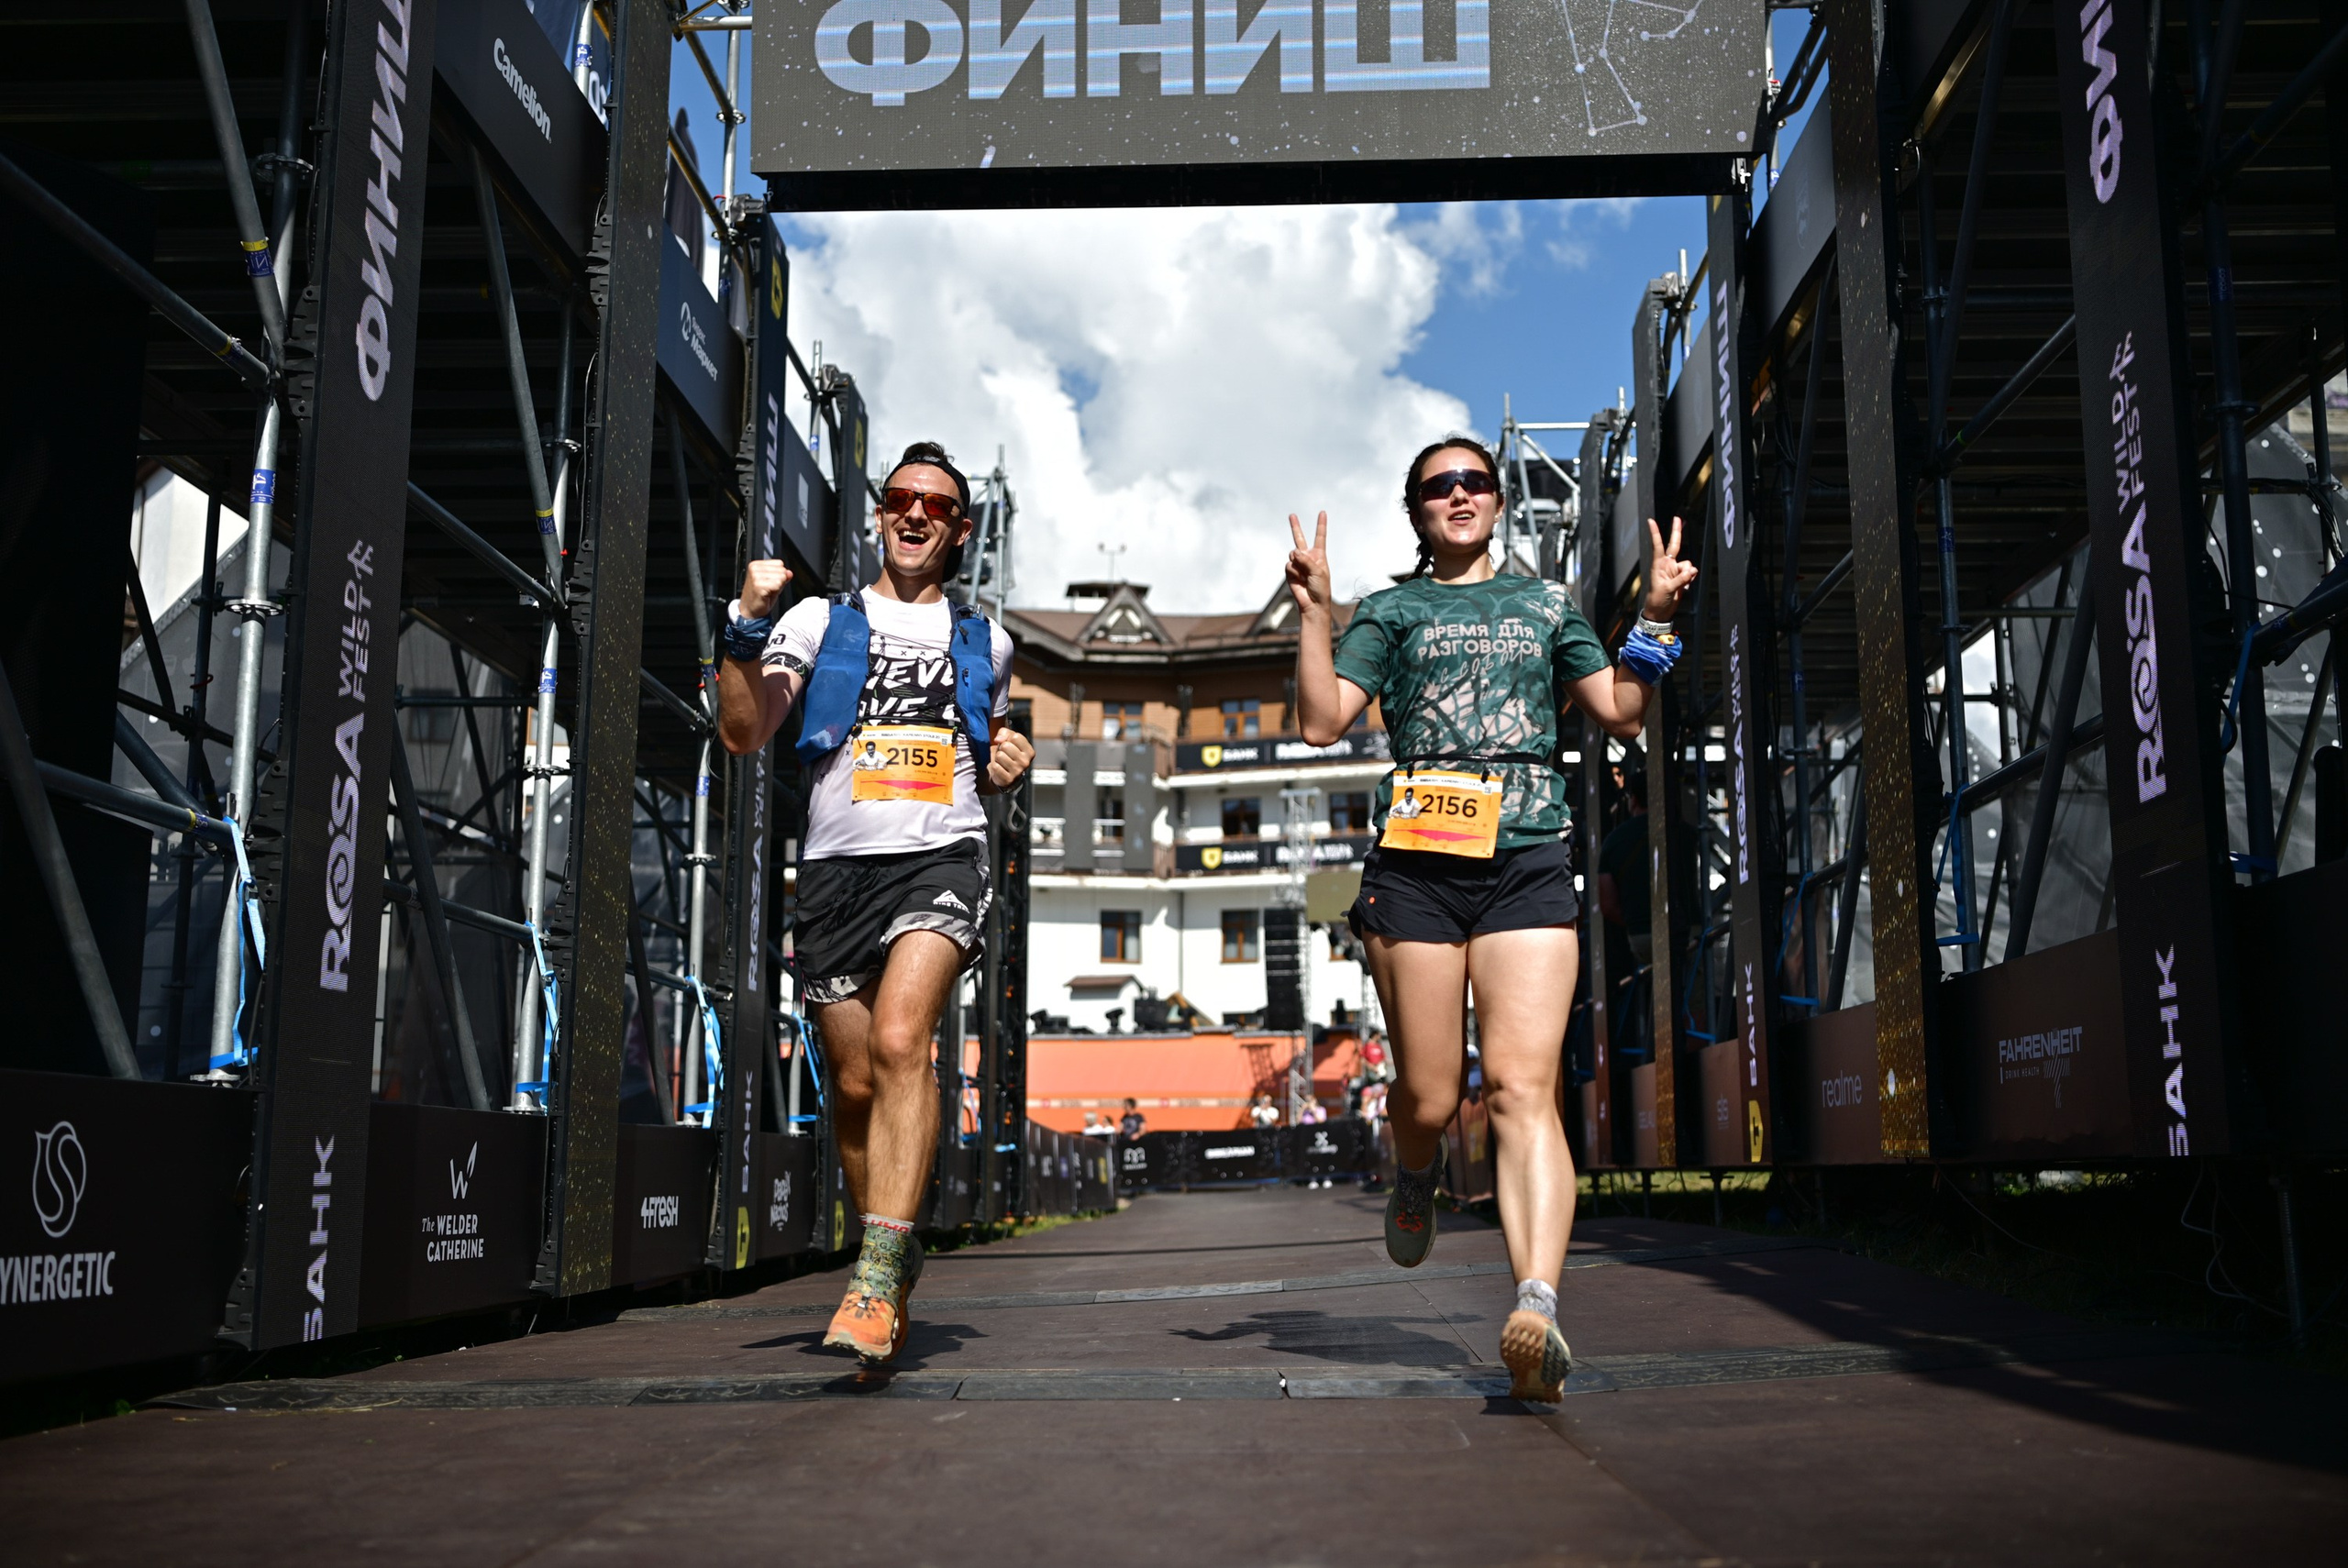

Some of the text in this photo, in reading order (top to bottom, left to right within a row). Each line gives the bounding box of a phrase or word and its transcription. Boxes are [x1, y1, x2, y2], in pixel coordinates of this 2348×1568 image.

[493, 37, 552, 145] Camelion
[814, 0, 1491, 107] ФИНИШ
[1716, 279, 1735, 549] ФИНИШ
[2123, 383, 2145, 501] FEST
[764, 392, 779, 561] НИШ
[353, 584, 372, 703] FEST
[1417, 639, 1543, 662] РАЗГОВОРОВ
[1423, 623, 1535, 642] ВРЕМЯ ДЛЯ
[2121, 500, 2167, 803] ROSA
[320, 580, 365, 992] ROSA WILD
[886, 747, 938, 768] 2155
[1419, 794, 1479, 819] 2156
[1744, 962, 1757, 1088] БАНК
[1998, 1025, 2083, 1064] FAHRENHEIT
[741, 1070, 753, 1193] БАНК
[1822, 1069, 1863, 1109] realme
[0, 1251, 116, 1305] YNERGETIC
[421, 1214, 478, 1235] The WELDER
[426, 1238, 484, 1263] CATHERINE
